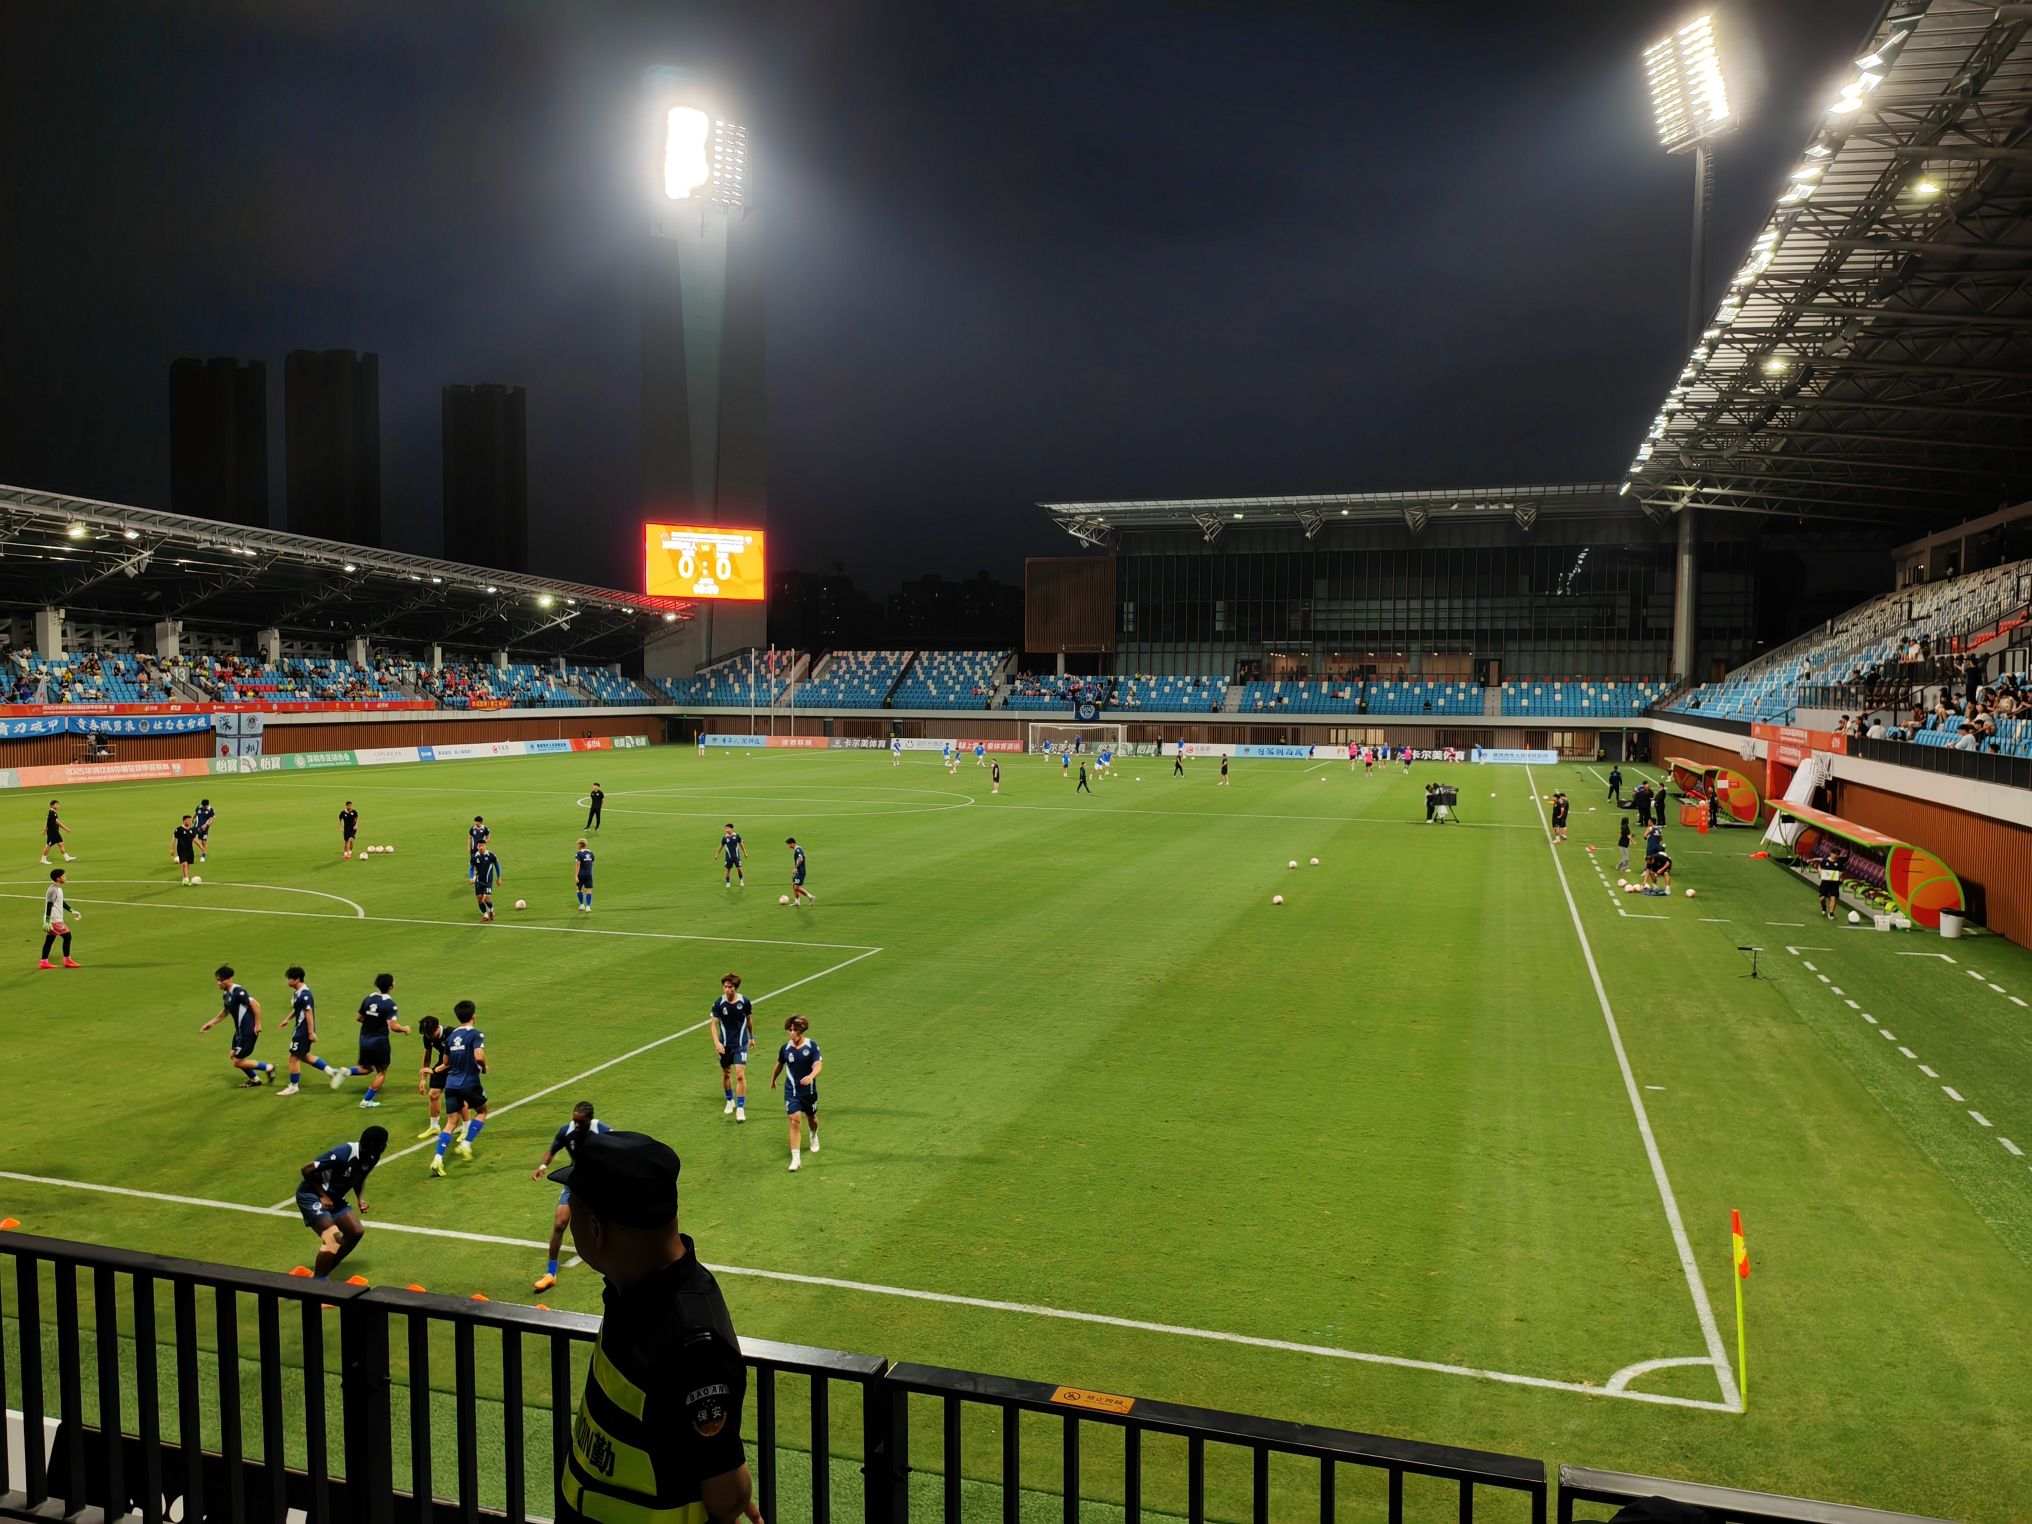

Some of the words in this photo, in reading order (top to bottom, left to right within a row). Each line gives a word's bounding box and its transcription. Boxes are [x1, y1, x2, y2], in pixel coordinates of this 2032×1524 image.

[174, 668, 186, 682] 13
[844, 739, 886, 748] 卡尔美体育
[697, 1406, 722, 1422] 保安
